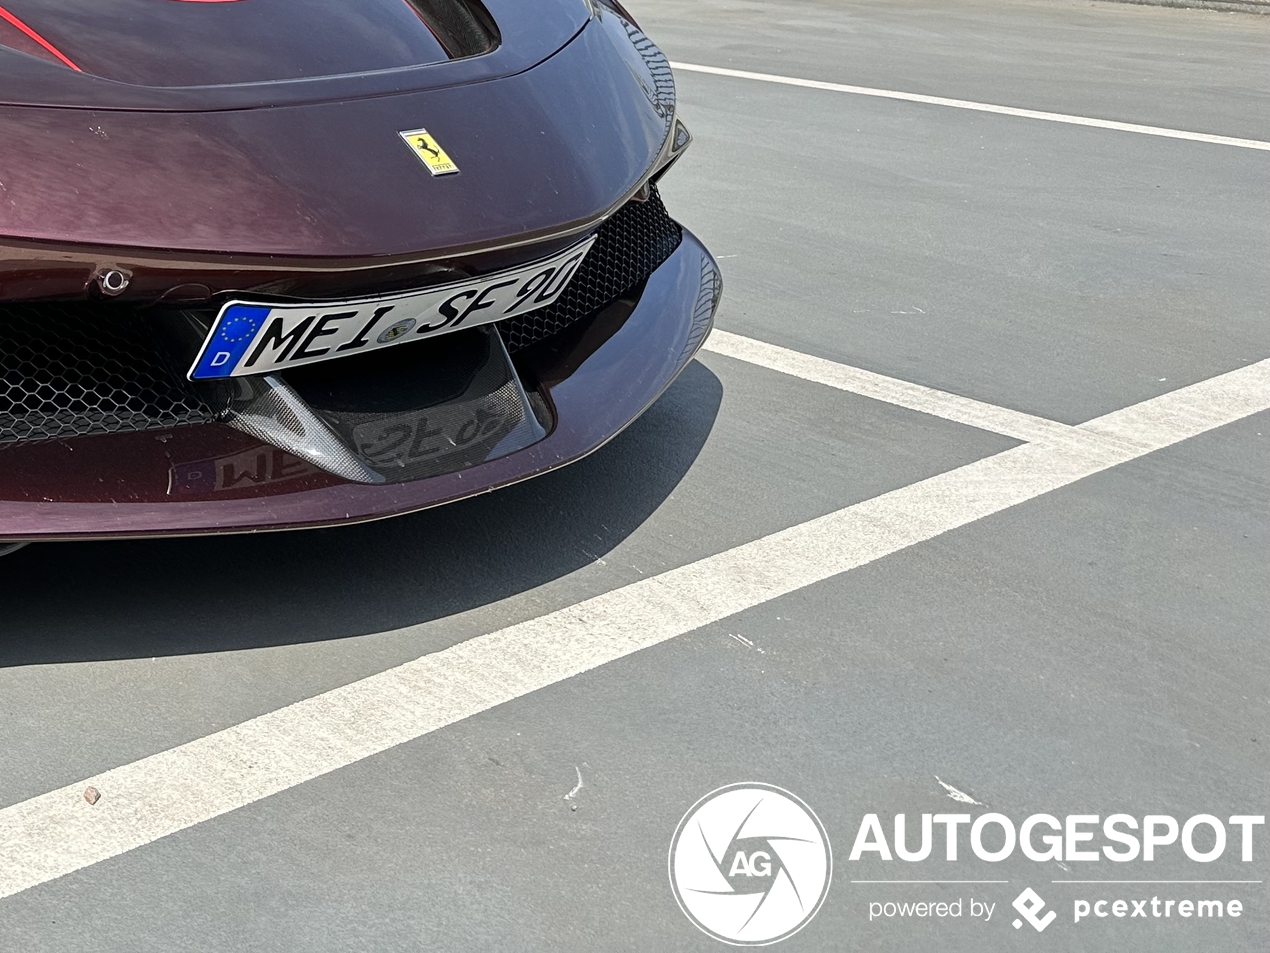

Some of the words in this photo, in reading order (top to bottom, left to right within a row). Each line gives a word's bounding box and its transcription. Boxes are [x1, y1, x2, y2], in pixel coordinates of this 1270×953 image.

[210, 351, 231, 367] D
[243, 306, 392, 367] MEI
[416, 278, 519, 334] SF
[503, 251, 583, 314] 90
